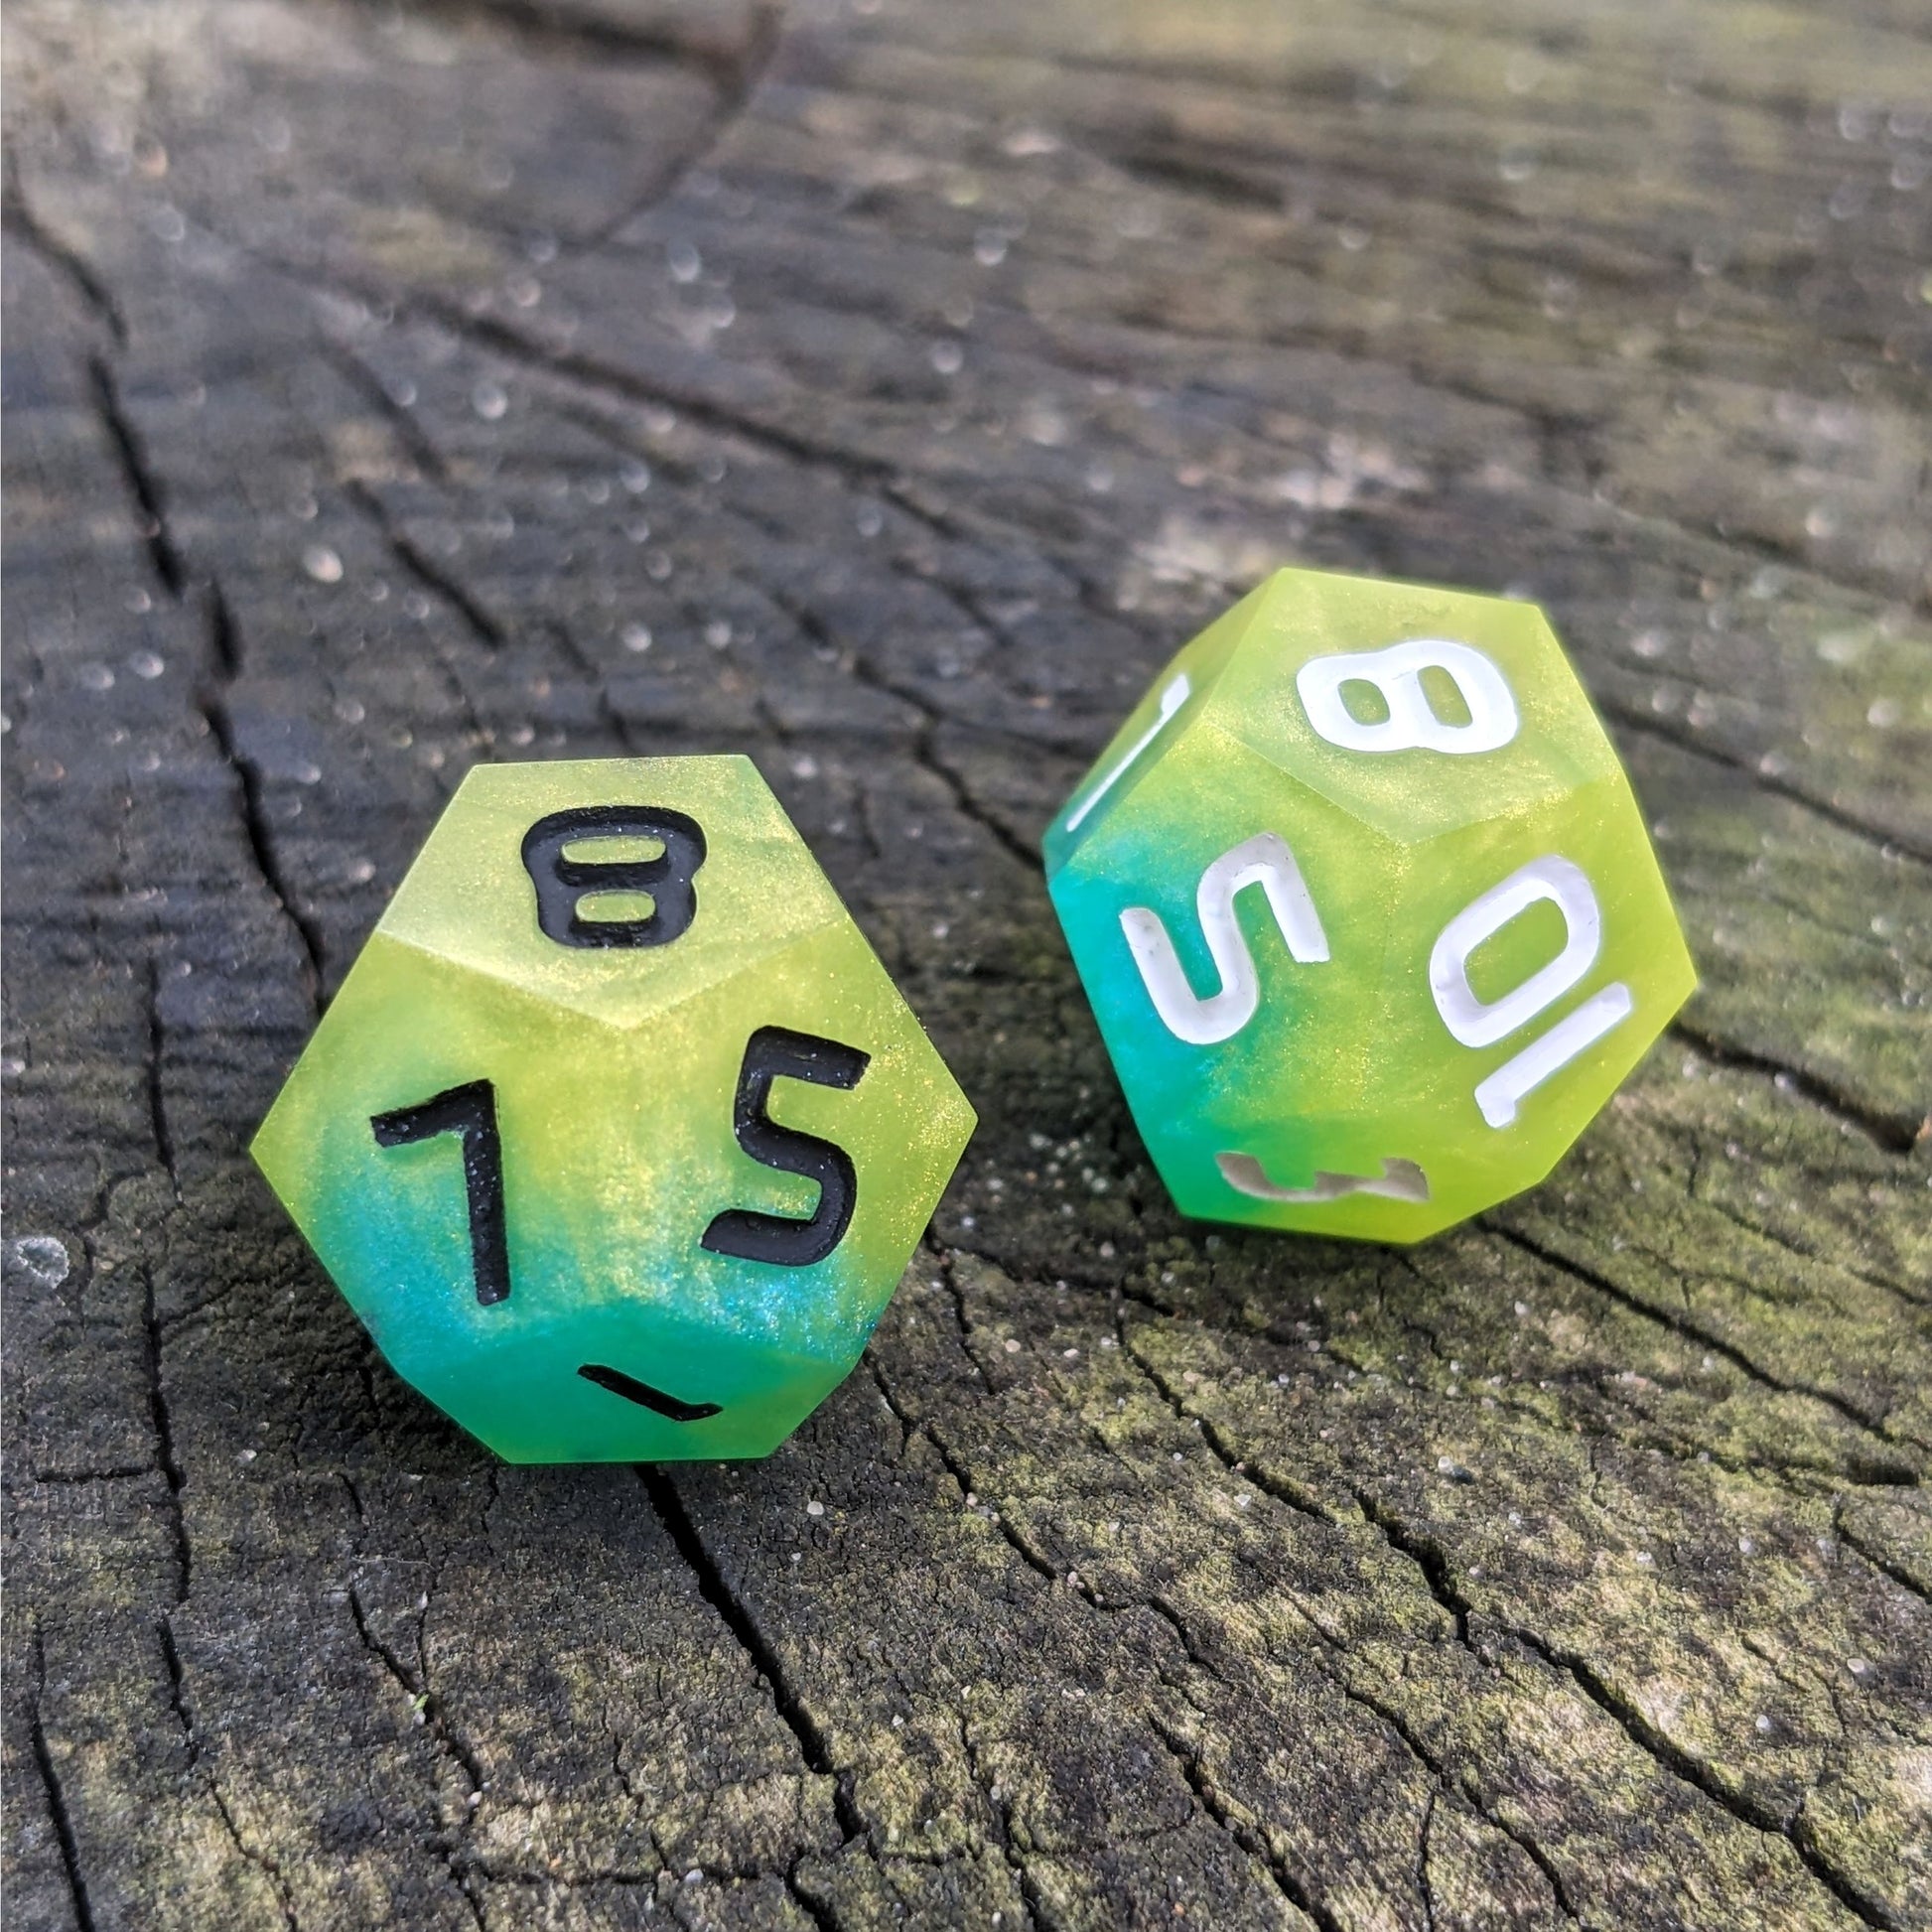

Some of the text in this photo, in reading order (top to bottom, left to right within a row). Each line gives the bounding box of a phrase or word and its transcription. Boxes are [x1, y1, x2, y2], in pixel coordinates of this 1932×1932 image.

[1296, 640, 1519, 755] 8
[521, 805, 707, 950] 8
[1120, 832, 1330, 1044] 5
[1429, 854, 1630, 1129] 10
[370, 1078, 510, 1306] 7
[700, 1026, 871, 1267] 5
